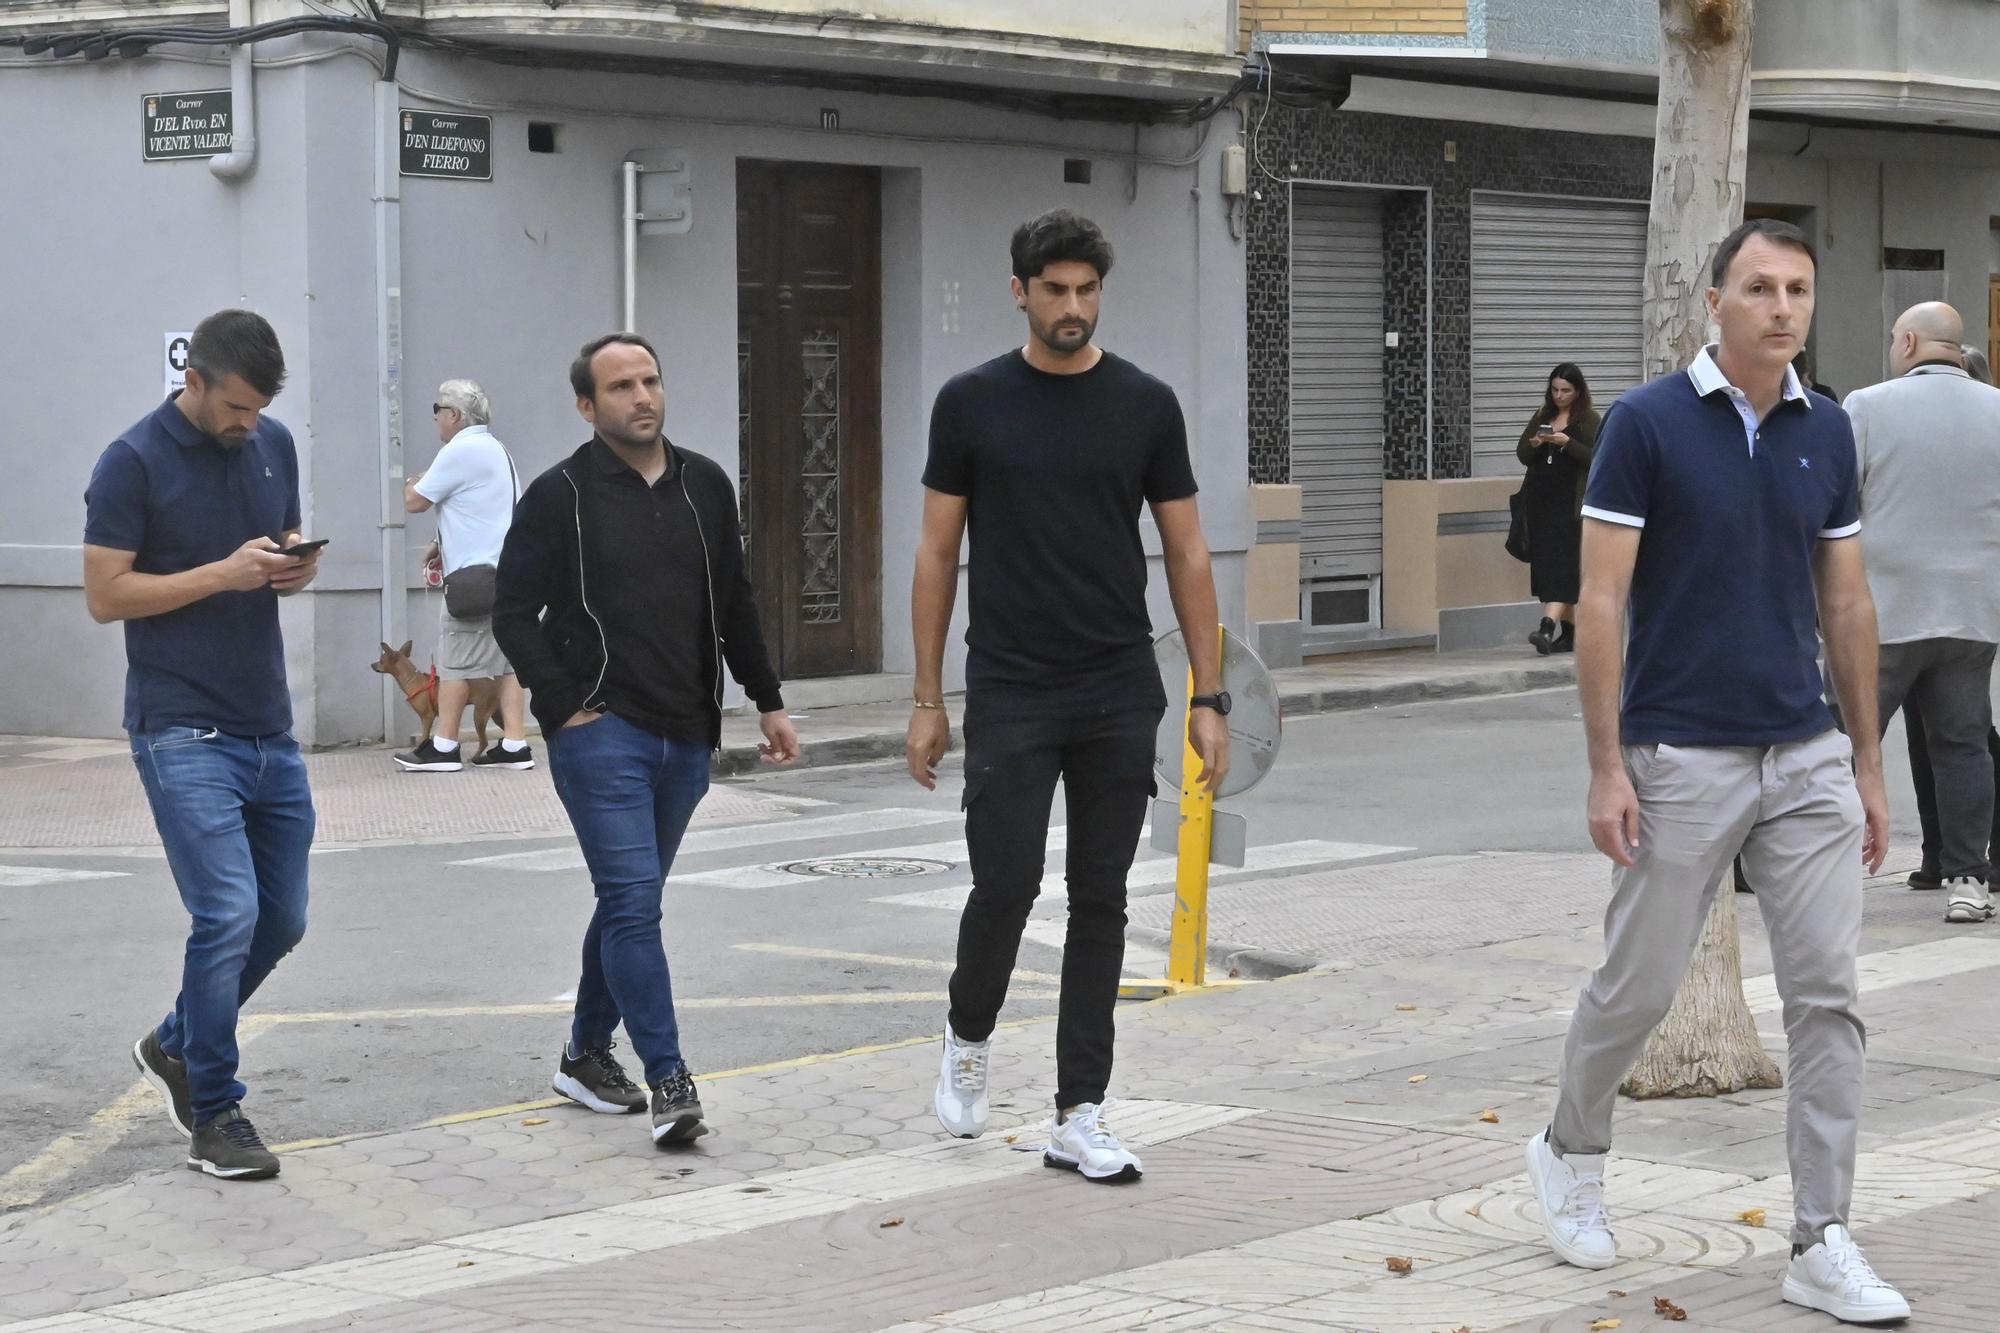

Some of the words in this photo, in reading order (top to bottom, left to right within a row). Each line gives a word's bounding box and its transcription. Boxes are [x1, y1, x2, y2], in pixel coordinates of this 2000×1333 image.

[176, 99, 204, 110] Carrer
[210, 113, 228, 129] EN
[431, 118, 459, 130] Carrer
[150, 135, 192, 152] VICENTE
[194, 133, 232, 149] VALERO
[405, 133, 430, 149] D'EN
[431, 135, 486, 153] ILDEFONSO
[422, 154, 470, 171] FIERRO
